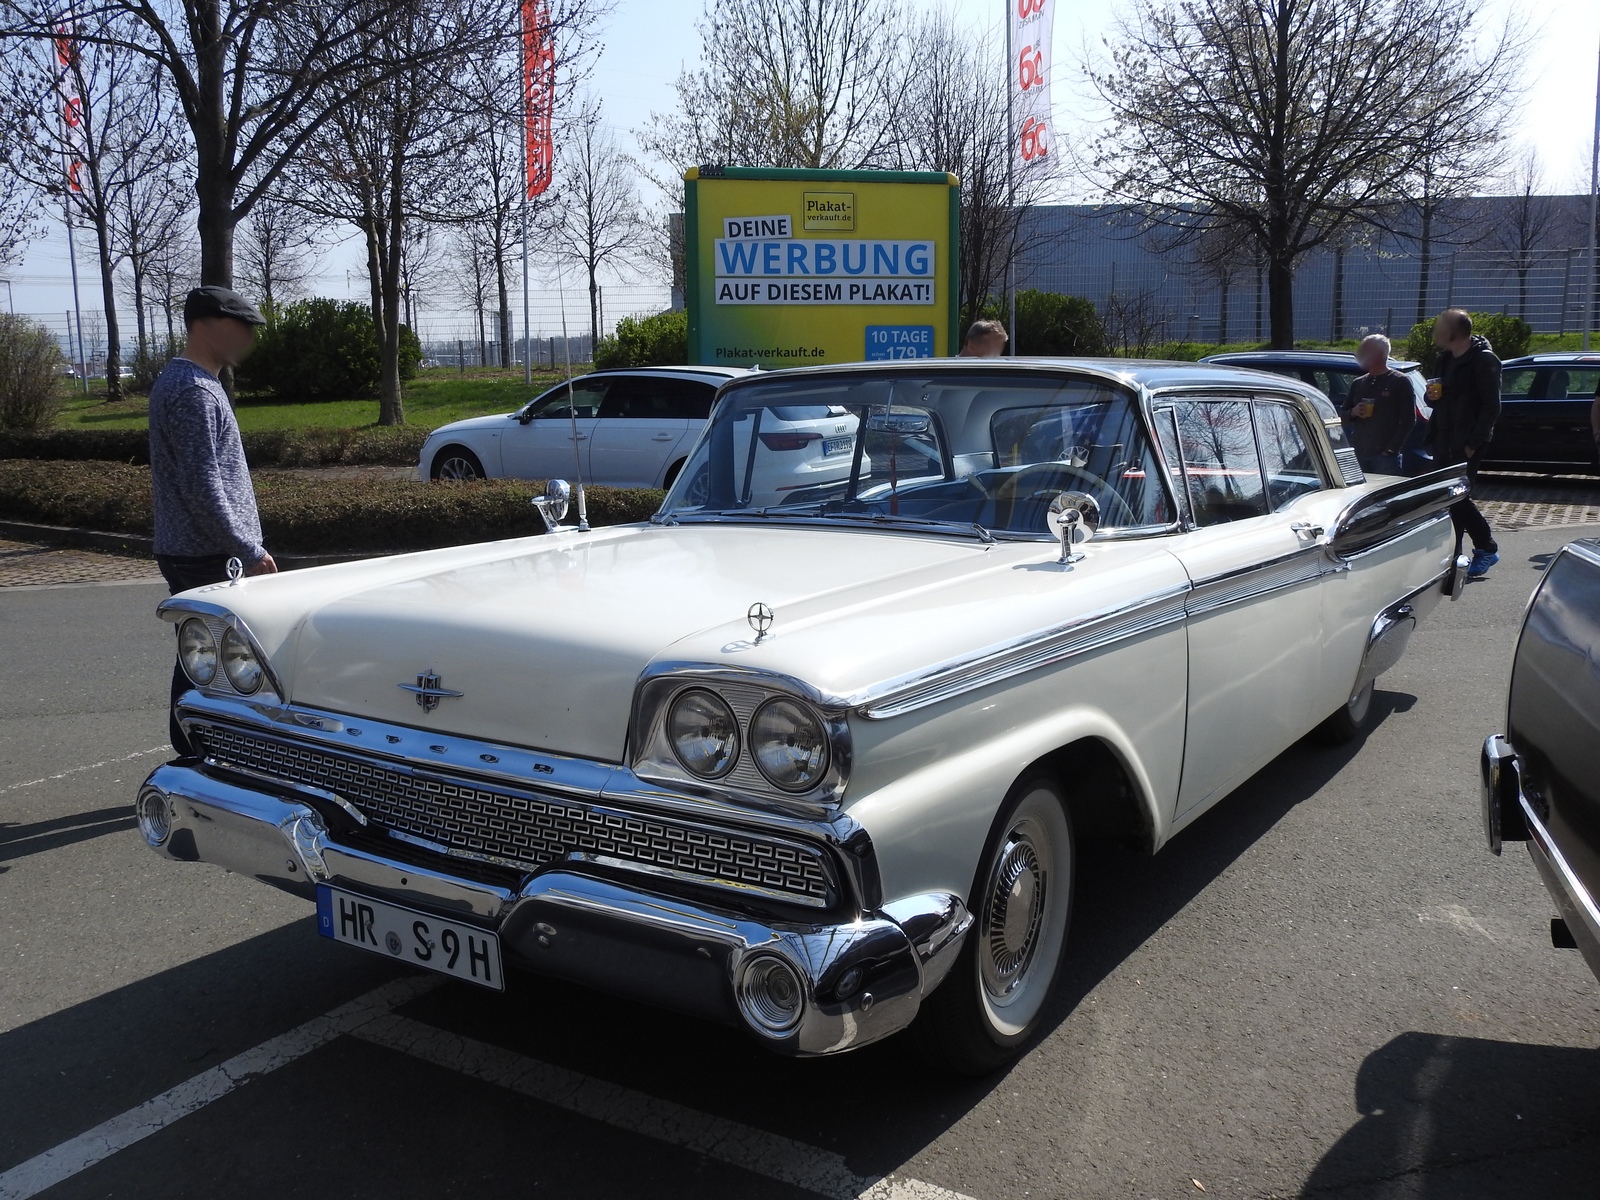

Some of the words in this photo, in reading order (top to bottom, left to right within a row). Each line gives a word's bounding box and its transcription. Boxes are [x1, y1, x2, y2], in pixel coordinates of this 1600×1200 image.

[807, 200, 852, 212] Plakat-
[807, 213, 852, 222] verkauft.de
[728, 219, 788, 238] DEINE
[719, 242, 929, 275] WERBUNG
[719, 284, 761, 301] AUF
[767, 284, 842, 301] DIESEM
[849, 284, 930, 301] PLAKAT!
[871, 330, 888, 343] 10
[891, 330, 928, 343] TAGE
[715, 347, 826, 358] Plakat-verkauft.de
[323, 916, 330, 927] D
[339, 897, 378, 946] HR
[412, 920, 492, 982] S9H
